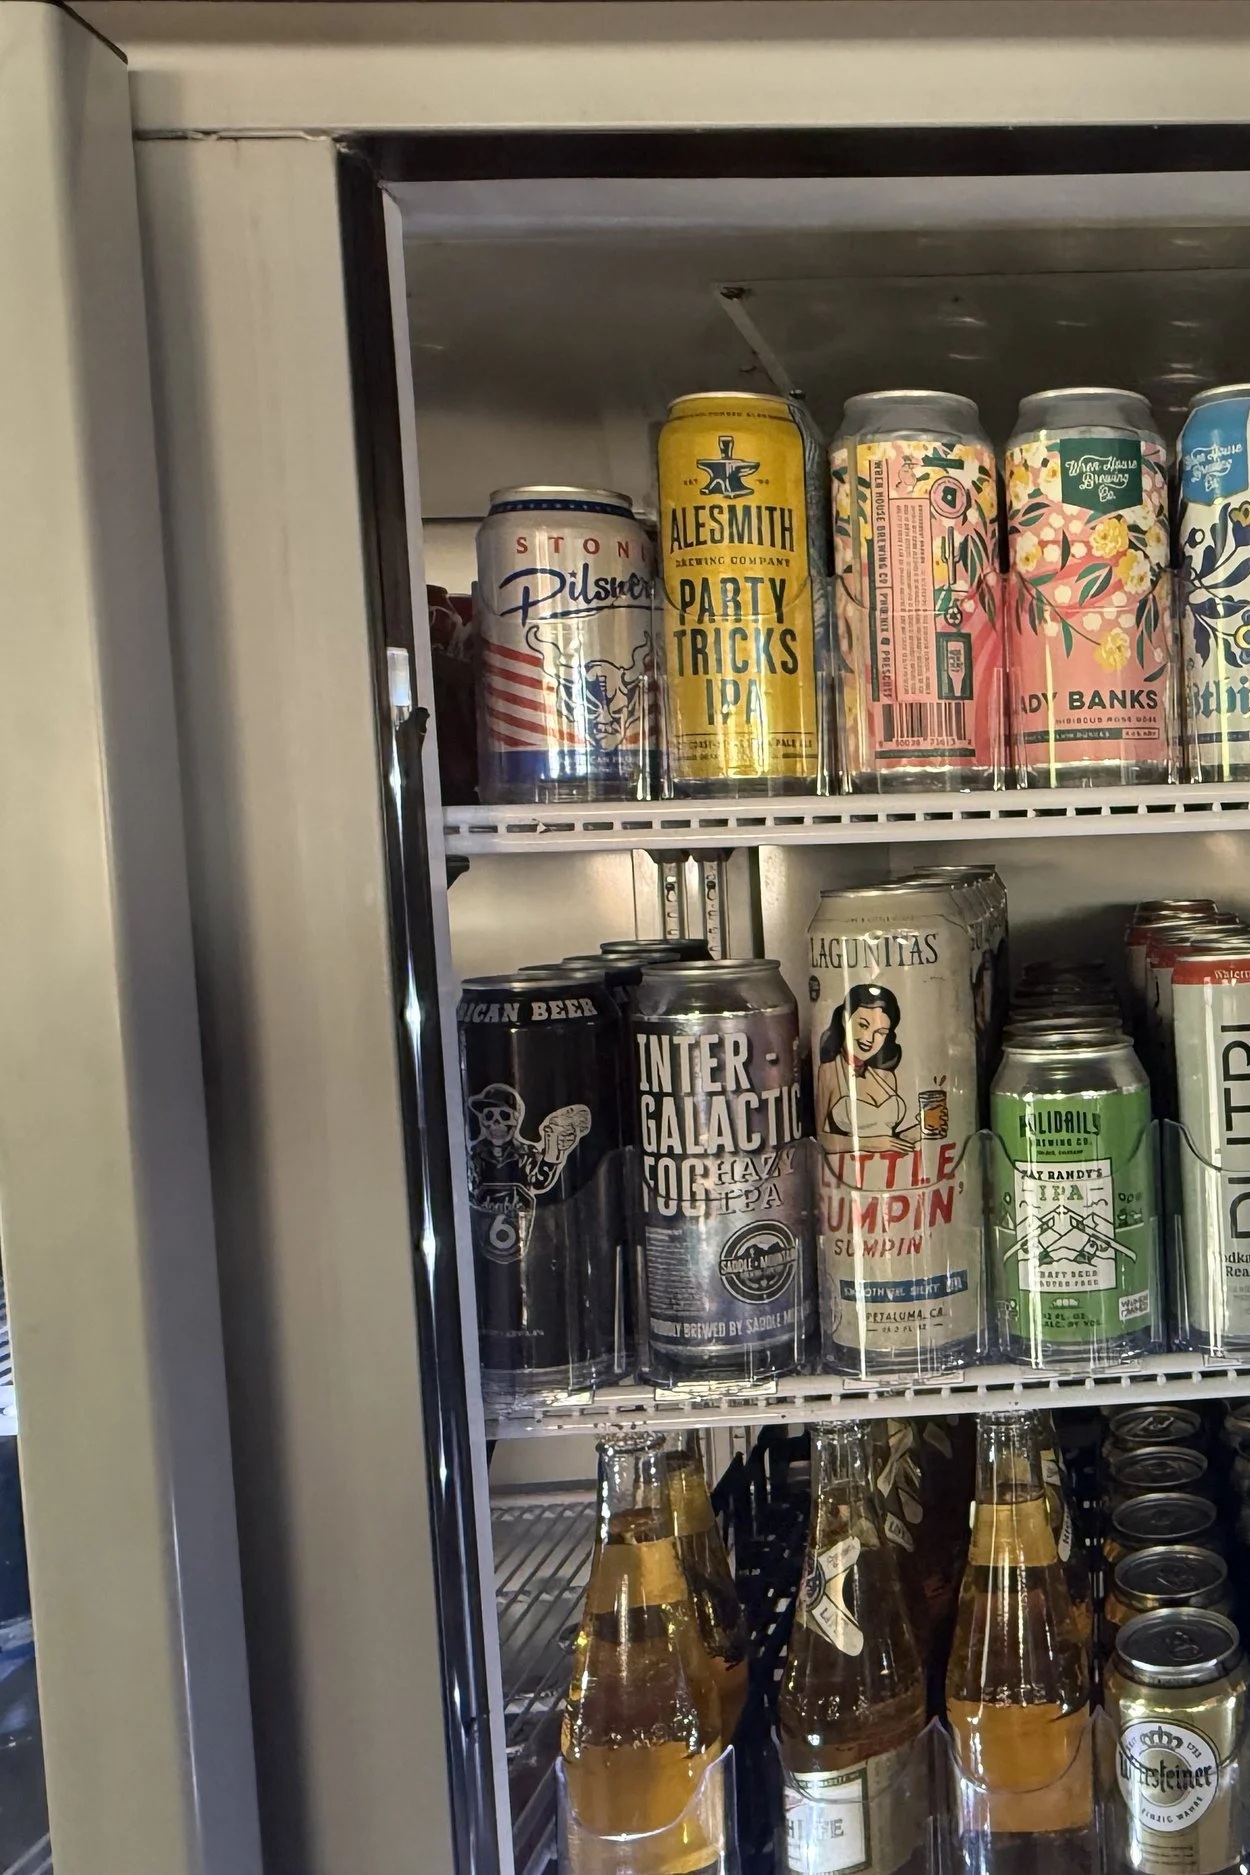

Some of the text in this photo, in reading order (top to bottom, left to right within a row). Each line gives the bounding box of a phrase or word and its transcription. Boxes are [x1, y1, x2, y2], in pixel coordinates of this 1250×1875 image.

[1065, 455, 1138, 477] Wren House
[1079, 472, 1130, 490] Brewing
[876, 492, 887, 521] HOUSE
[670, 504, 795, 554] ALESMITH
[676, 556, 790, 567] BREWING COMPANY
[876, 524, 889, 569] BREWING
[500, 562, 652, 627] Pilsner
[680, 577, 786, 625] PARTY
[674, 627, 798, 676] TRICKS
[706, 678, 765, 725] IPA
[1068, 690, 1158, 710] BANKS
[810, 933, 940, 969] LAGUNITAS
[531, 998, 598, 1021] BEER
[641, 1083, 802, 1154] GALACTIC
[1036, 1138, 1072, 1147] REWING
[713, 1146, 796, 1186] HAZY
[821, 1142, 957, 1190] LITTLE
[1048, 1168, 1103, 1180] RANDY'S
[643, 1155, 706, 1217] FOG
[715, 1182, 784, 1215] IPA
[1038, 1184, 1084, 1201] IPA
[822, 1180, 964, 1234] UMPIN'
[489, 1215, 516, 1249] 6
[834, 1231, 933, 1257] SUMPIN'
[684, 1322, 726, 1338] BREWED
[729, 1320, 743, 1335] BY
[746, 1313, 781, 1333] SADDLE
